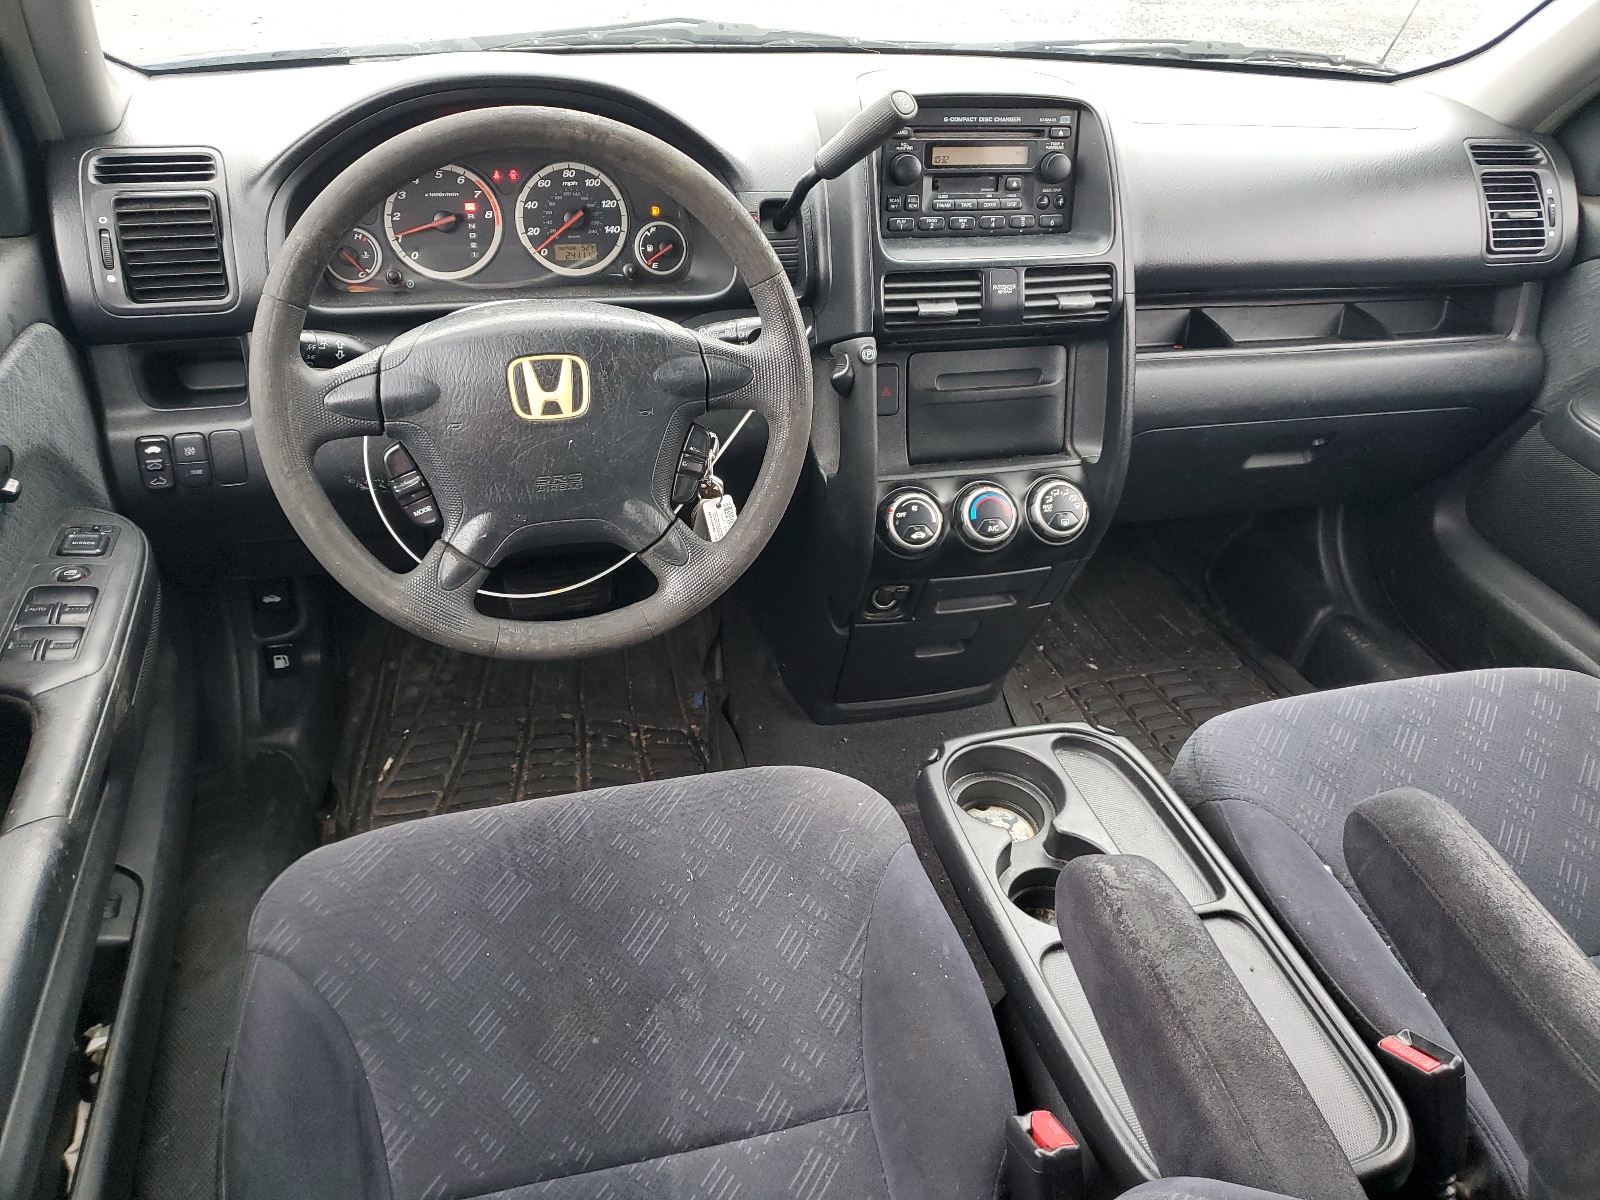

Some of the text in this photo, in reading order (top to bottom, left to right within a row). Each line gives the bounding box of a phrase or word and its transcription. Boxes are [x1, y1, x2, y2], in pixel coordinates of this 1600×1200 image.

[434, 170, 443, 178] 5
[562, 170, 576, 178] 80
[457, 176, 465, 184] 6
[538, 179, 551, 188] 60
[584, 179, 600, 187] 100
[398, 191, 406, 199] 3
[474, 190, 482, 198] 7
[525, 201, 538, 209] 40
[601, 200, 617, 208] 120
[536, 472, 583, 483] SRS
[413, 505, 433, 517] MODE
